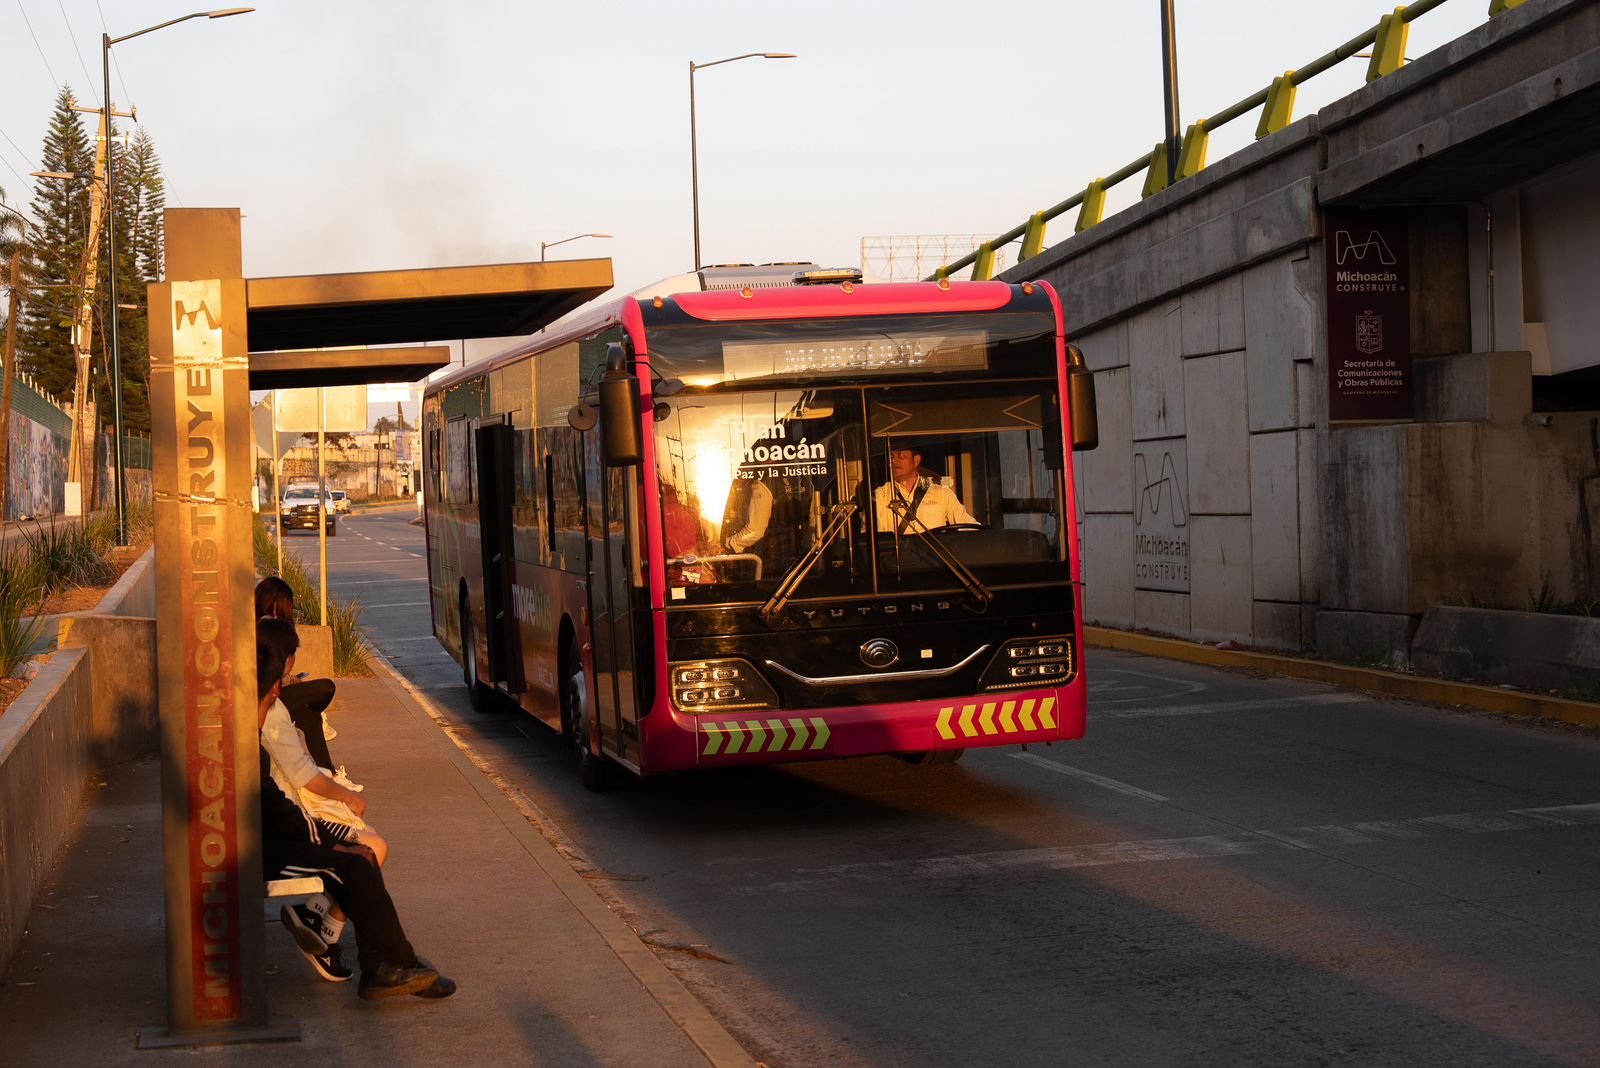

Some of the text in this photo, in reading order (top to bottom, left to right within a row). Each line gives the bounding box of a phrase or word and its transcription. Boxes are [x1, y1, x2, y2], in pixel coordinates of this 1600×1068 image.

[1336, 271, 1397, 282] Michoacán
[1336, 283, 1398, 292] CONSTRUYE
[1385, 359, 1396, 367] de
[1337, 369, 1403, 377] Comunicaciones
[1337, 378, 1403, 388] y Obras Públicas
[736, 464, 827, 481] Paz y la Justicia
[1135, 534, 1188, 558] Michoacán
[1135, 563, 1188, 581] CONSTRUYE
[803, 601, 950, 619] YUTONG
[187, 368, 231, 998] MICHOACAN CONSTRUYE
